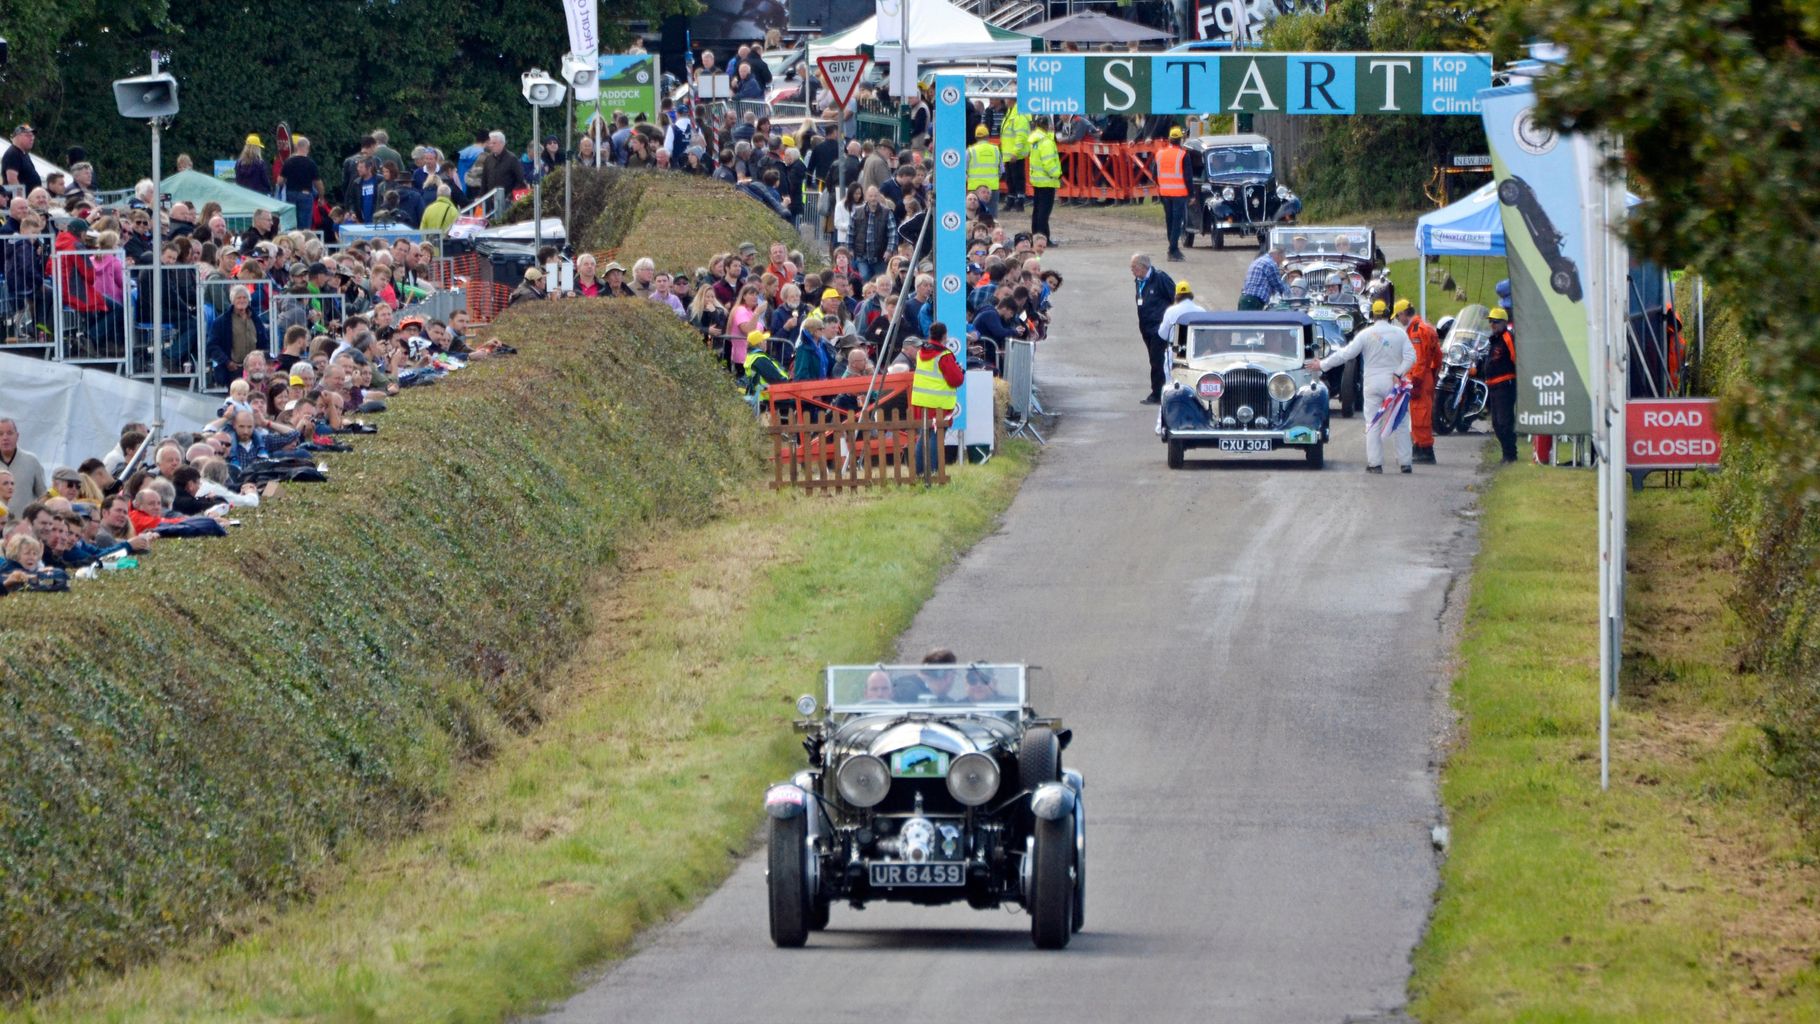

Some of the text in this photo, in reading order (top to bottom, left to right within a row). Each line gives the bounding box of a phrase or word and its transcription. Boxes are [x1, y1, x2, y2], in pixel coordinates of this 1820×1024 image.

[829, 61, 855, 73] GIVE
[1028, 57, 1062, 75] Kop
[1433, 57, 1467, 75] Kop
[833, 75, 851, 83] WAY
[1028, 77, 1053, 92] Hill
[1103, 57, 1412, 110] START
[1433, 77, 1457, 92] Hill
[1028, 97, 1079, 112] Climb
[1432, 97, 1482, 112] Climb
[1456, 157, 1476, 165] NEW
[1203, 384, 1218, 392] 304
[1643, 411, 1703, 428] ROAD
[1221, 440, 1270, 451] CXU 304
[1633, 439, 1717, 456] CLOSED
[875, 865, 960, 884] UR 6459
